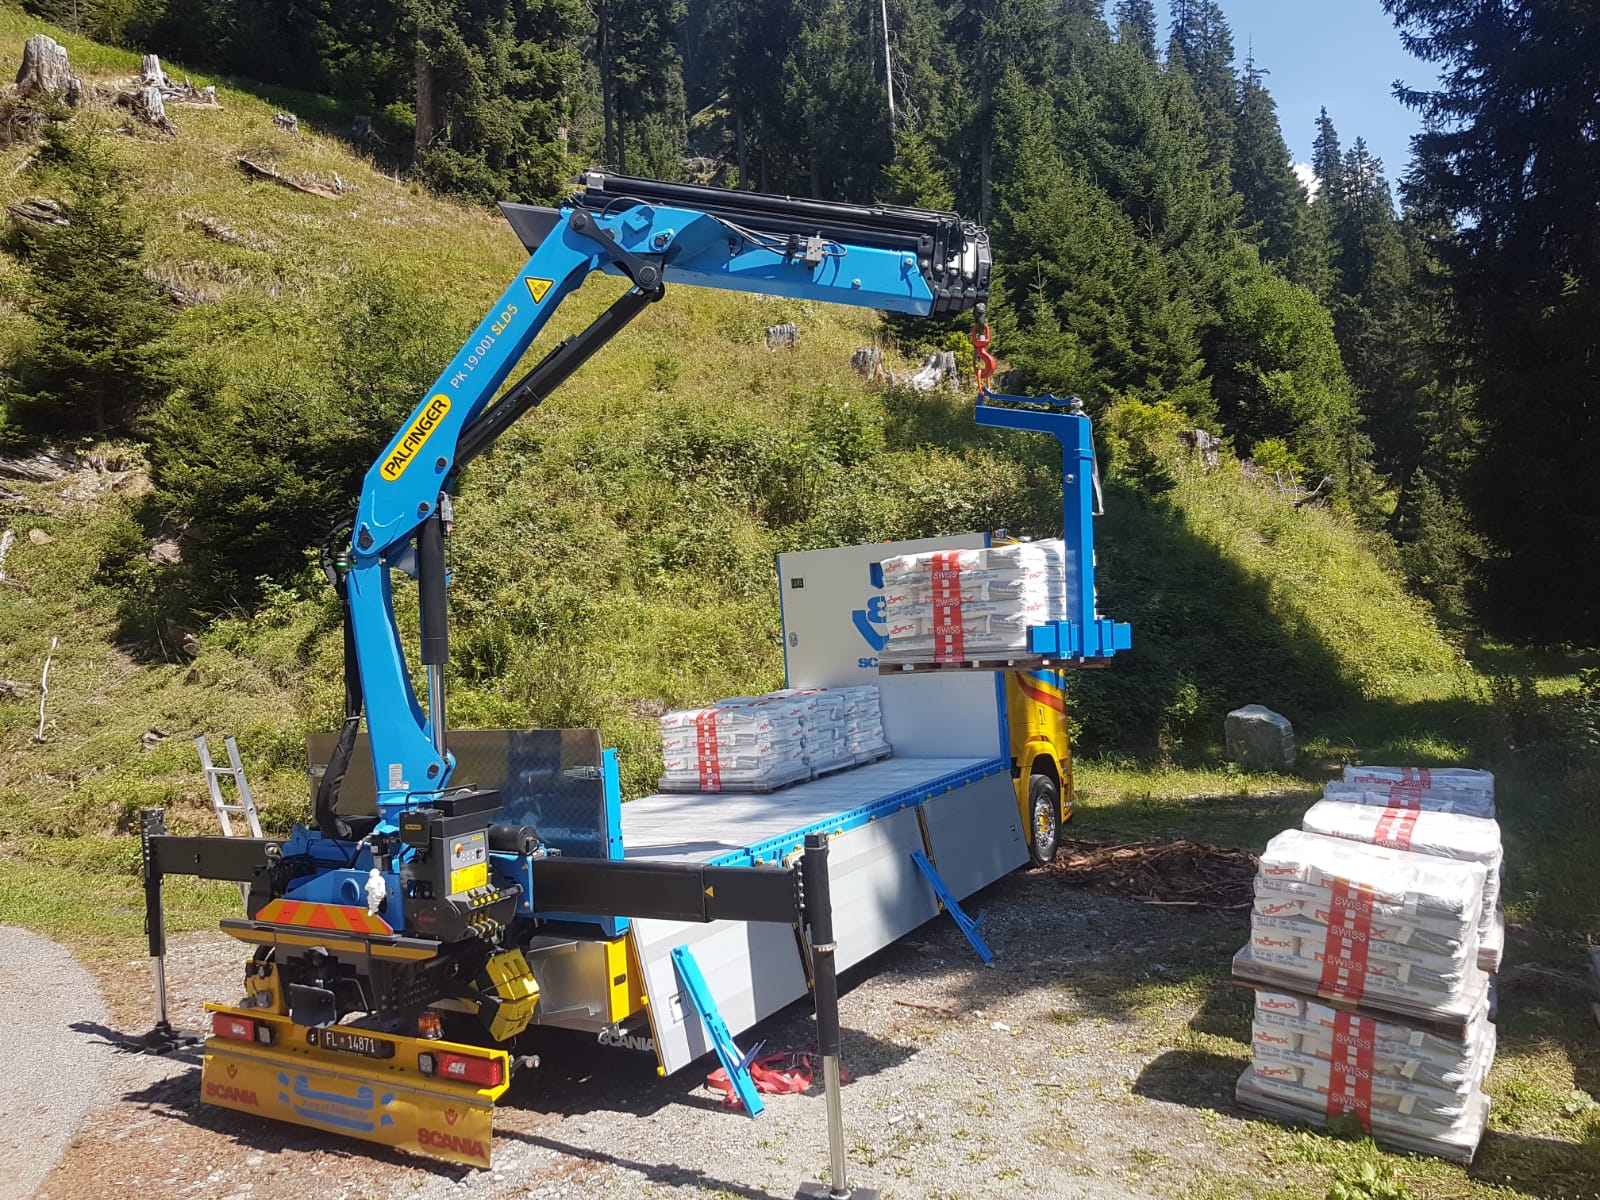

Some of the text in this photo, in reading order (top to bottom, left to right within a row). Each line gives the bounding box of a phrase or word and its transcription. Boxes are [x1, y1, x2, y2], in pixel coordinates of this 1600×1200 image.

[450, 371, 469, 389] PK
[464, 335, 496, 371] 19.001
[384, 399, 448, 477] PALFINGER
[933, 571, 957, 580] SWISS
[935, 598, 960, 607] SWISS
[936, 626, 960, 634] SWISS
[1334, 896, 1369, 912] SWISS
[1331, 926, 1366, 942] SWISS
[1327, 955, 1362, 972] SWISS
[326, 1031, 338, 1046] FL
[347, 1035, 376, 1053] 14871
[1336, 1033, 1371, 1049] SWISS
[1334, 1063, 1369, 1079] SWISS
[206, 1081, 259, 1107] SCANIA
[1331, 1093, 1367, 1109] SWISS
[417, 1128, 486, 1159] SCANIA
